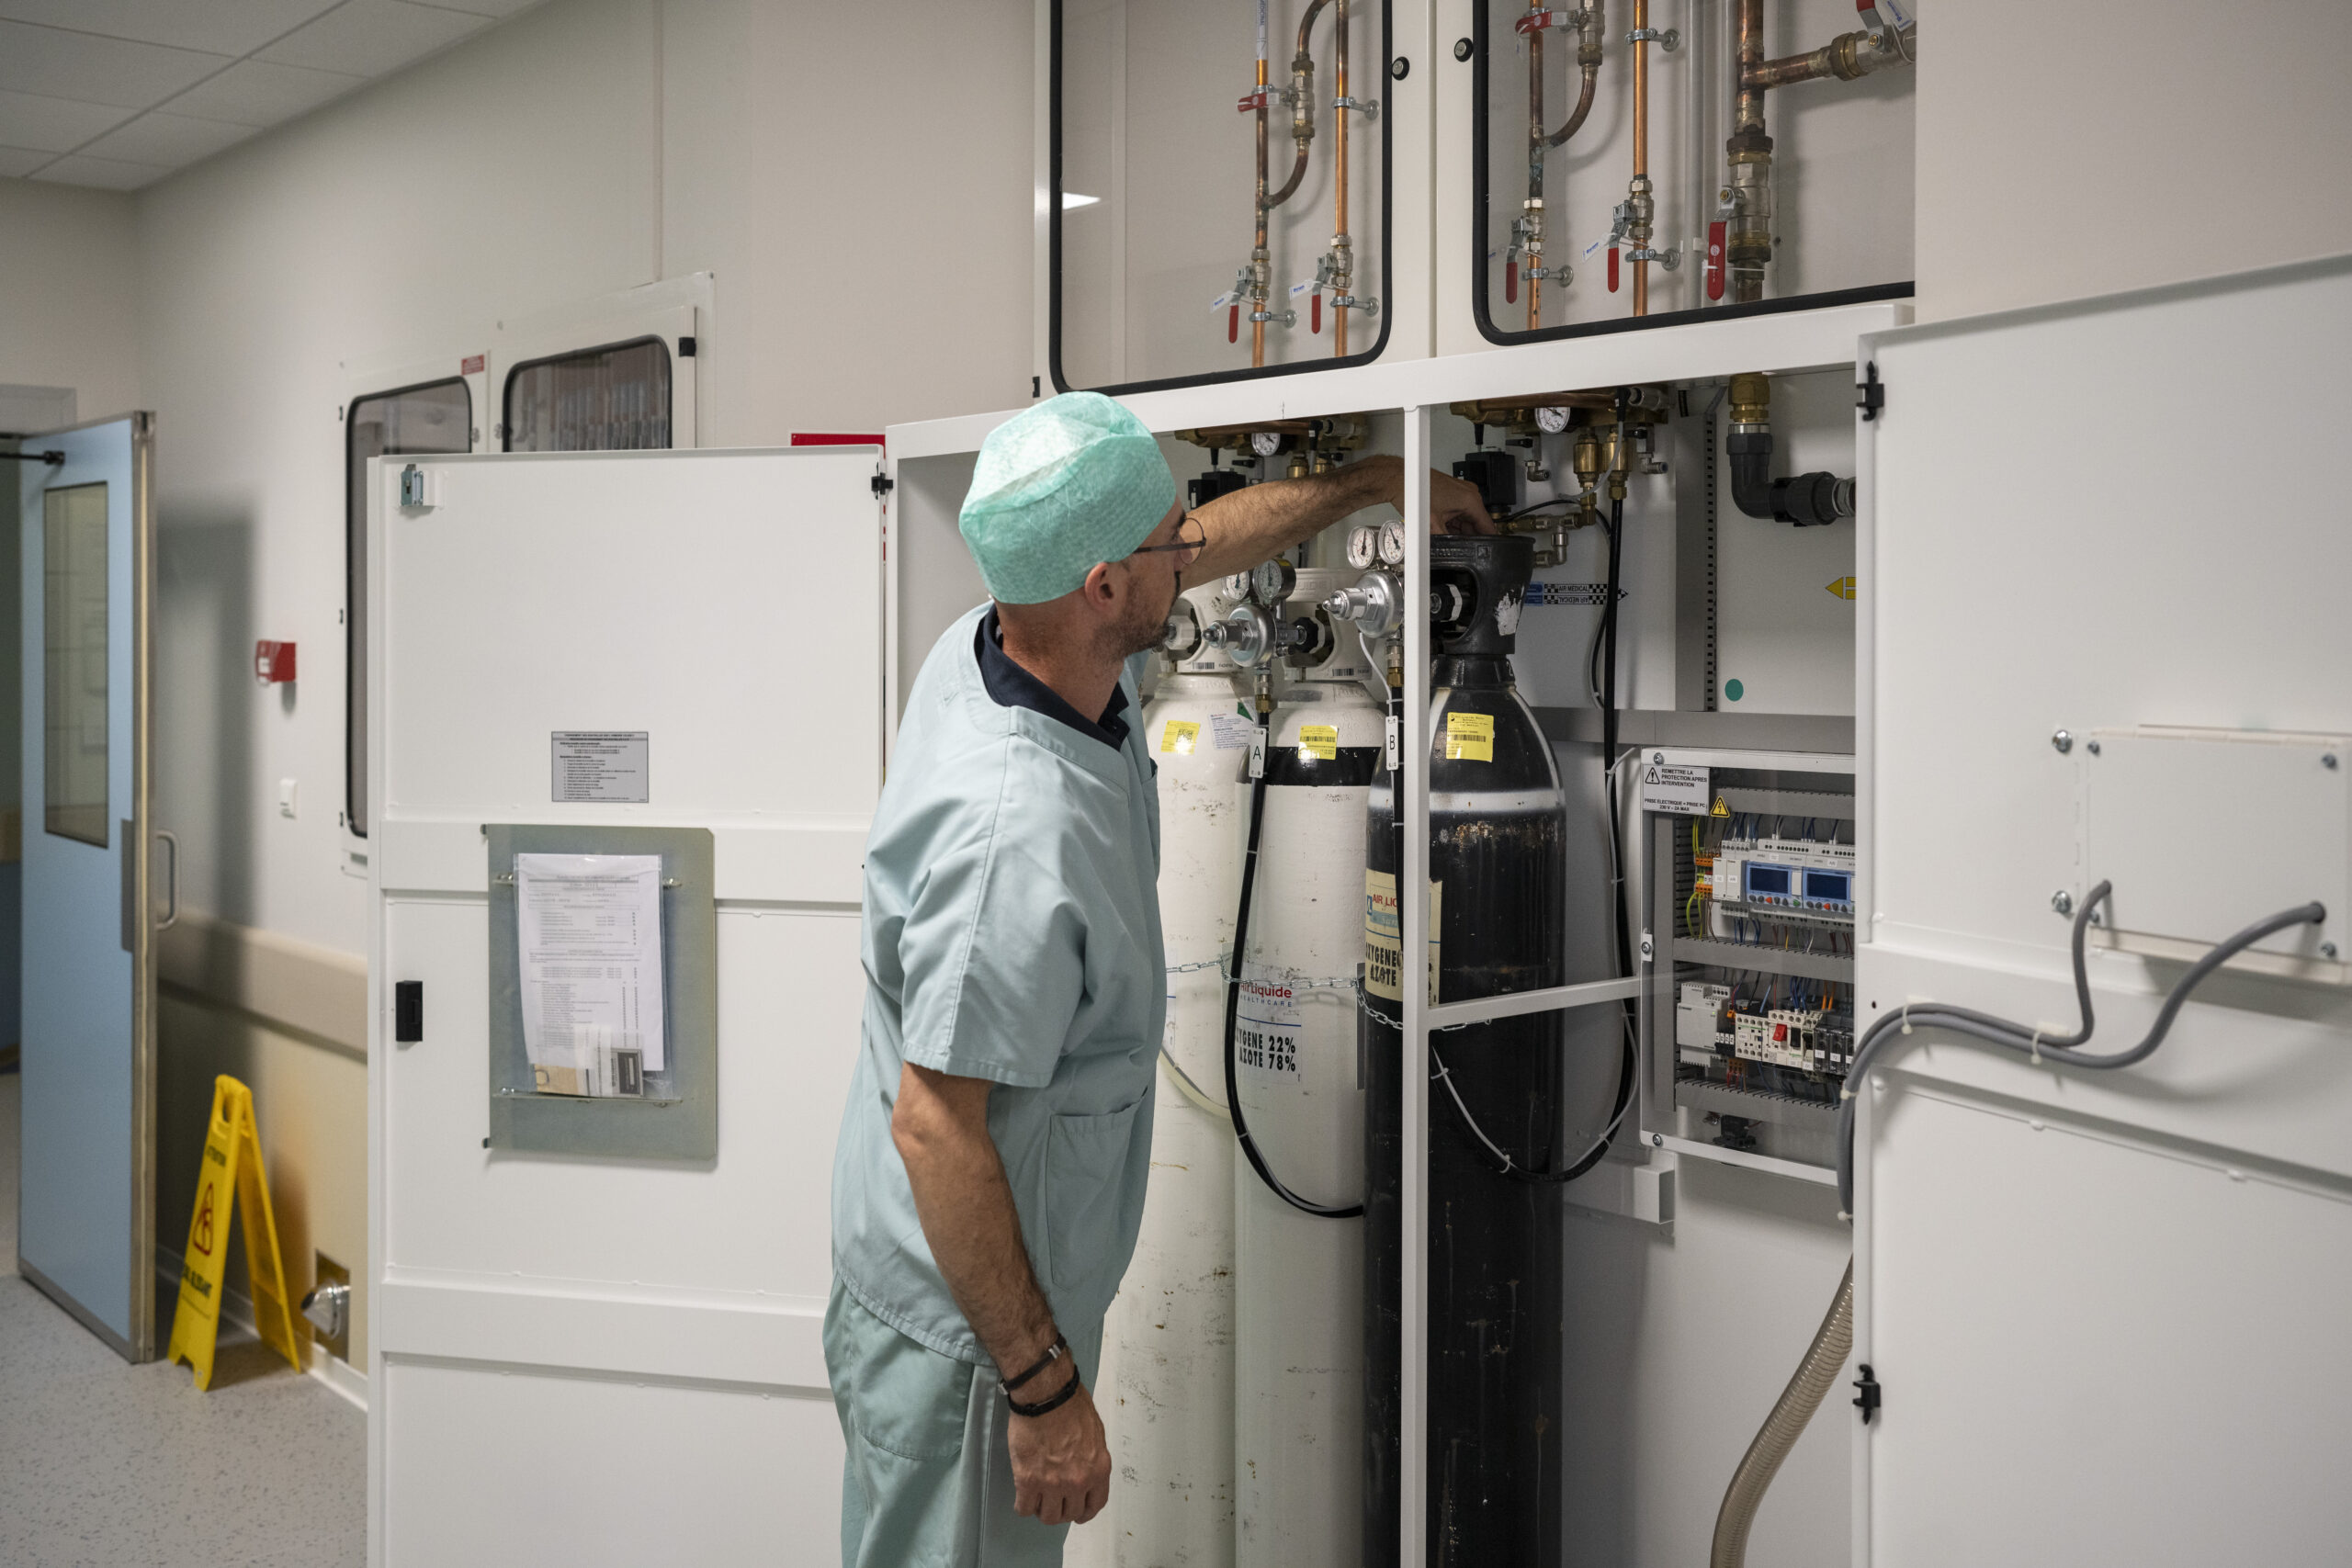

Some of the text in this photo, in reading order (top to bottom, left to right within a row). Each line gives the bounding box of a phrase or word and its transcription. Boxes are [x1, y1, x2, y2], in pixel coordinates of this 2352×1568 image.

[1389, 734, 1396, 750] B
[1252, 745, 1261, 761] A
[1372, 894, 1384, 905] AIR
[1370, 964, 1396, 987] AZOTE
[1250, 983, 1293, 998] Liquide
[1240, 995, 1293, 1008] HEALTHCARE
[1236, 1027, 1296, 1054] XYGENE 22%
[1238, 1046, 1296, 1072] AZOTE 78%
